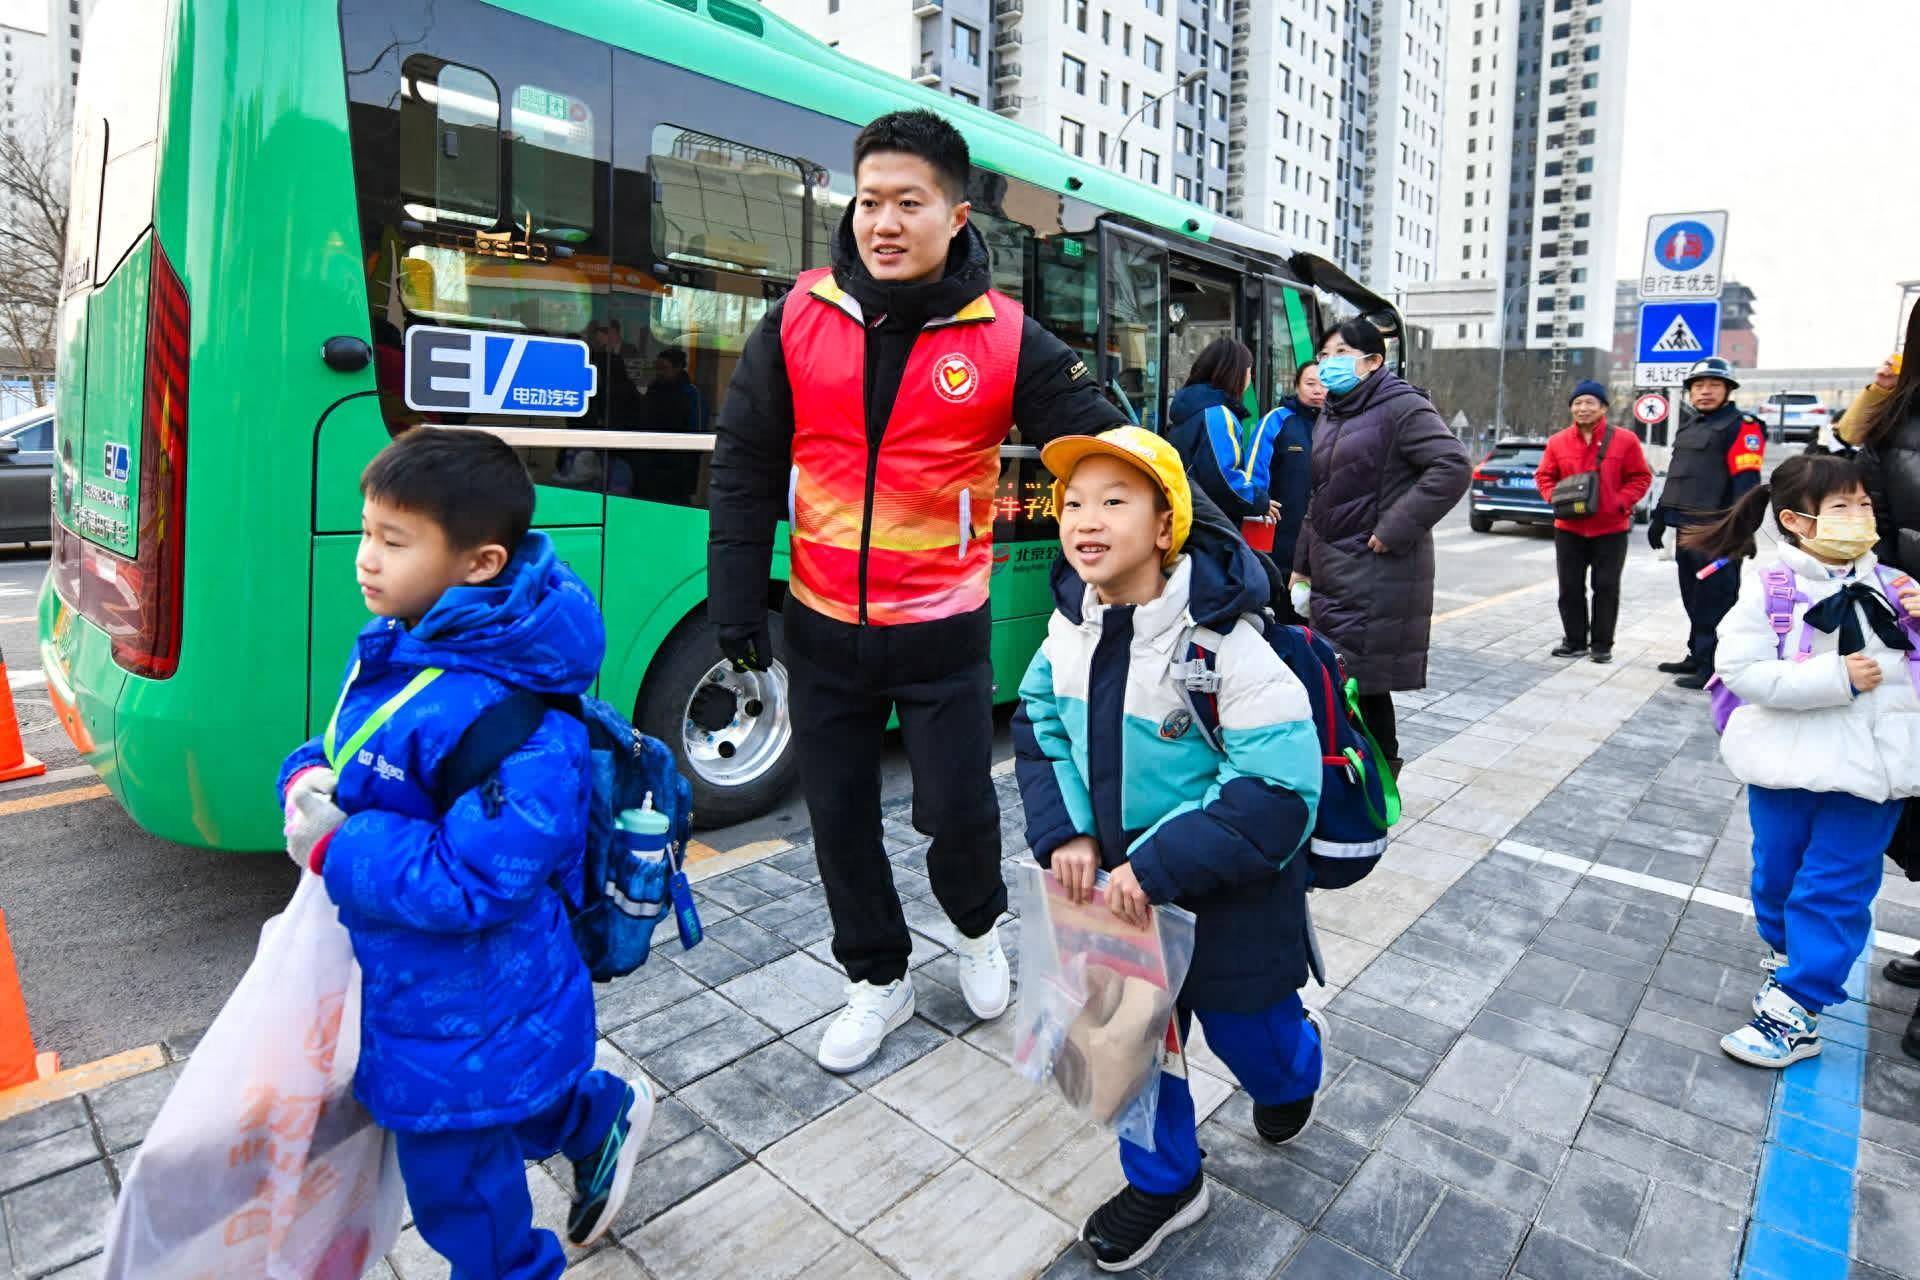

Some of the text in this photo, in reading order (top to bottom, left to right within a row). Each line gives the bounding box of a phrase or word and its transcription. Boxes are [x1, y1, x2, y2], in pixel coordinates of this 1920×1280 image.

[1644, 275, 1715, 292] 自行车优先
[513, 387, 579, 407] 电动汽车
